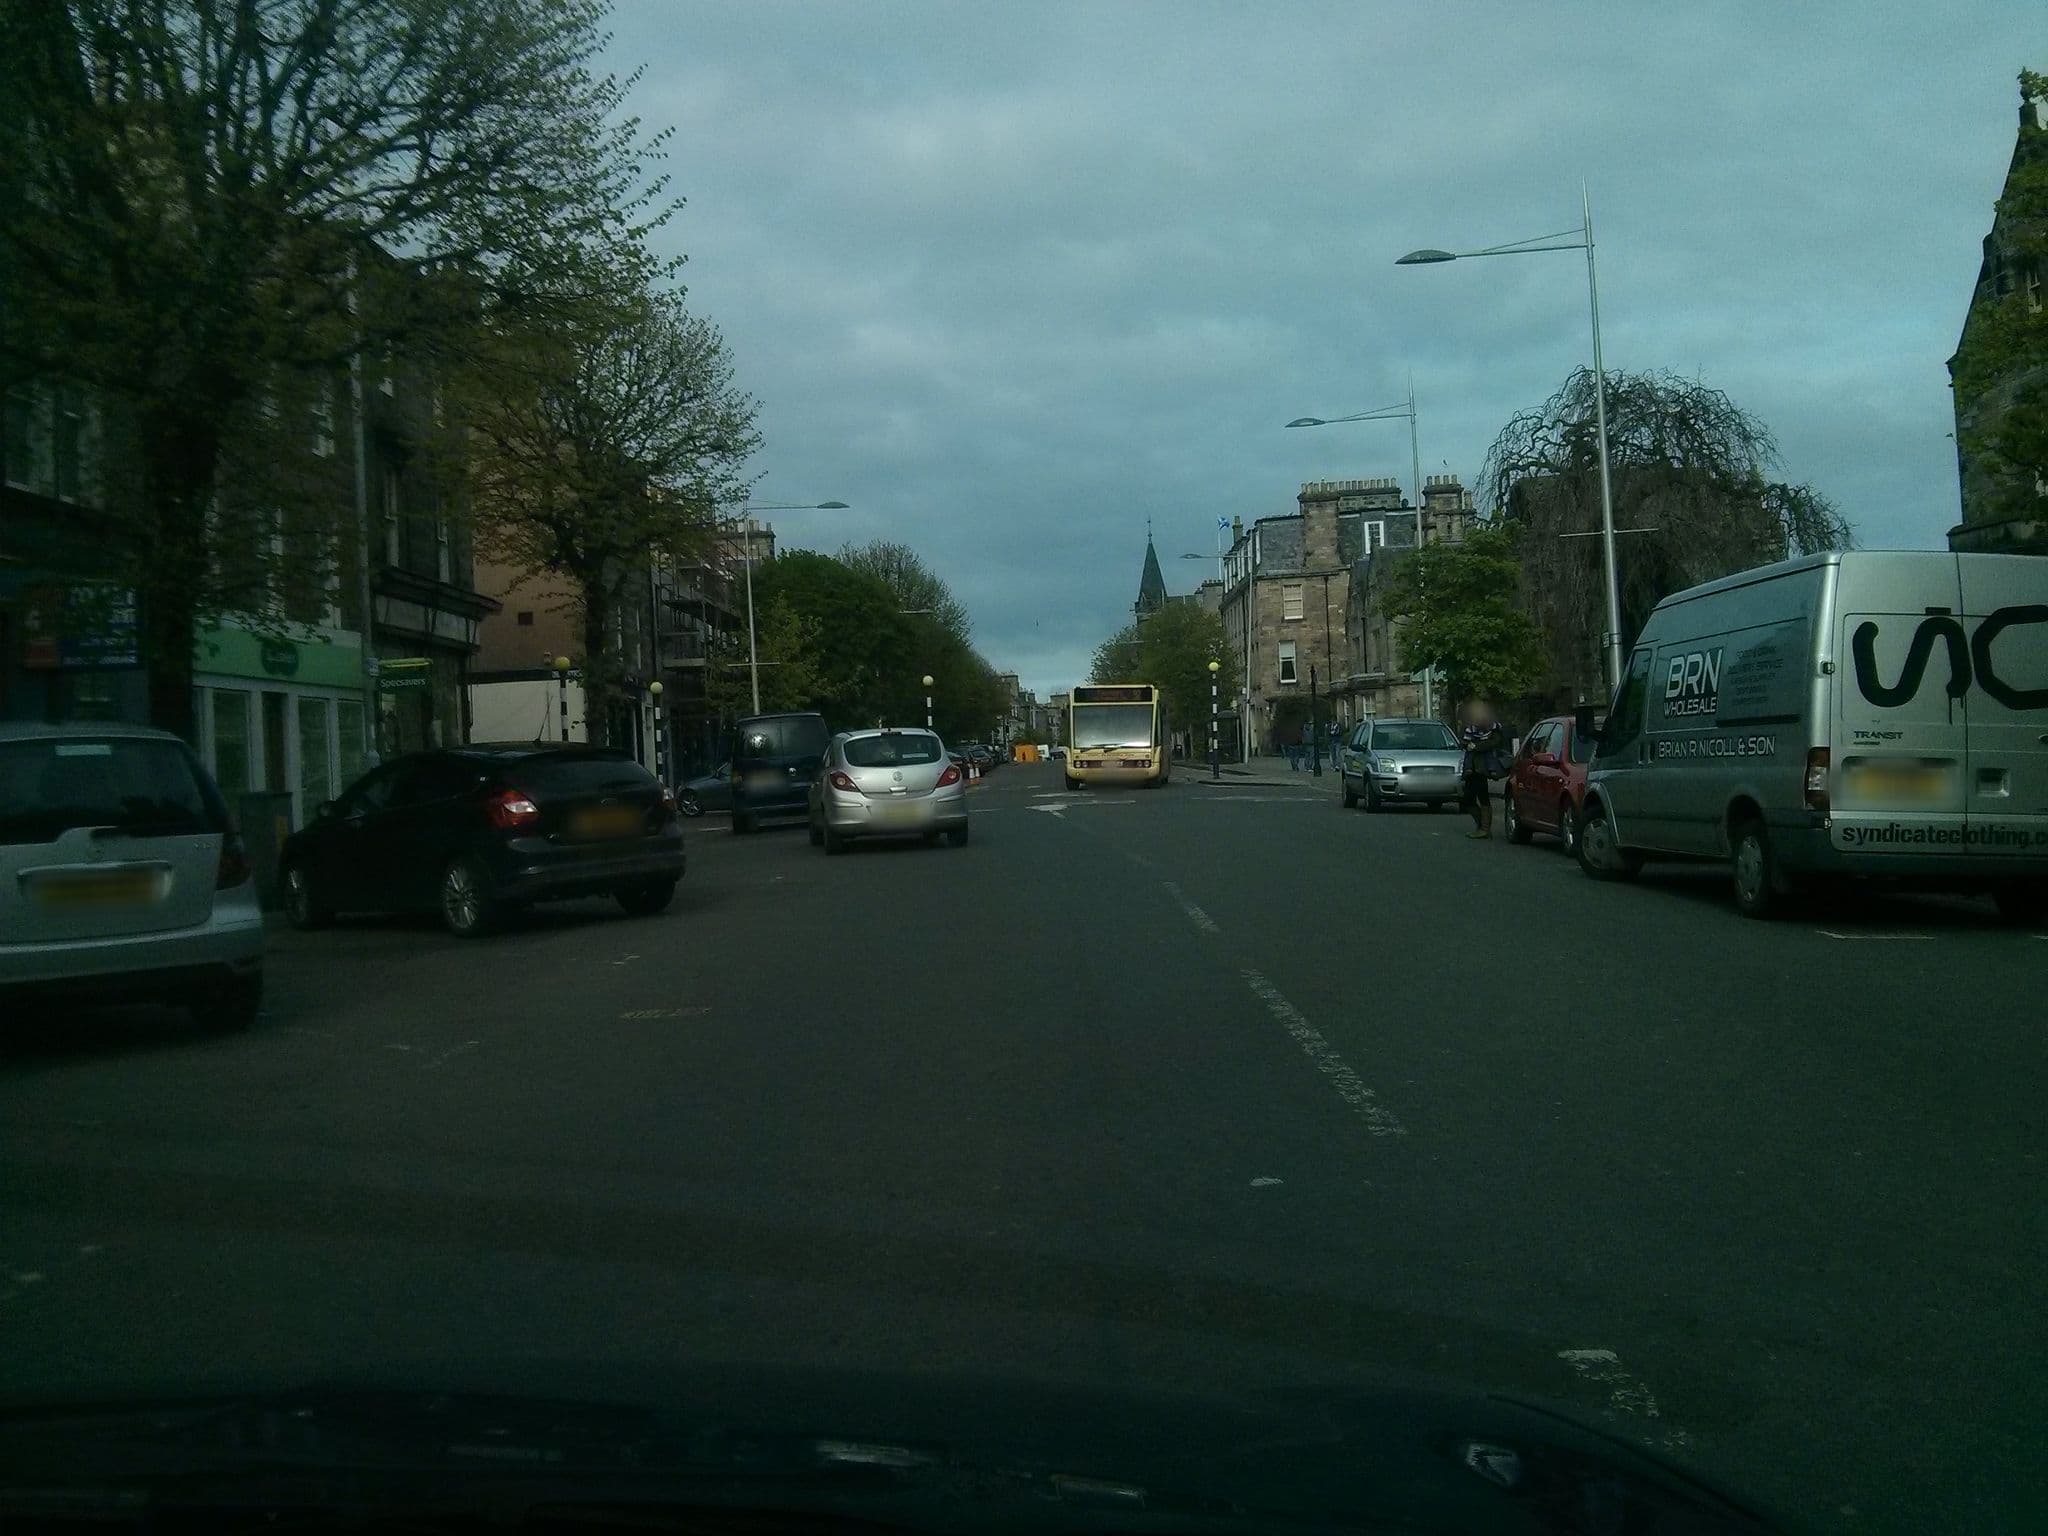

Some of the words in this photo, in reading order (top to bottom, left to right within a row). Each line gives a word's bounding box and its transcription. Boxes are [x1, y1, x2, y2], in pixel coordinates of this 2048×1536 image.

[1665, 648, 1722, 699] BRN
[1664, 697, 1718, 717] WHOLESALE
[1854, 730, 1903, 739] TRANSIT
[1659, 740, 1687, 758] BRIAN
[1688, 740, 1698, 757] R
[1699, 738, 1736, 757] NICOLL
[1738, 738, 1746, 755] &
[1747, 736, 1776, 756] SON
